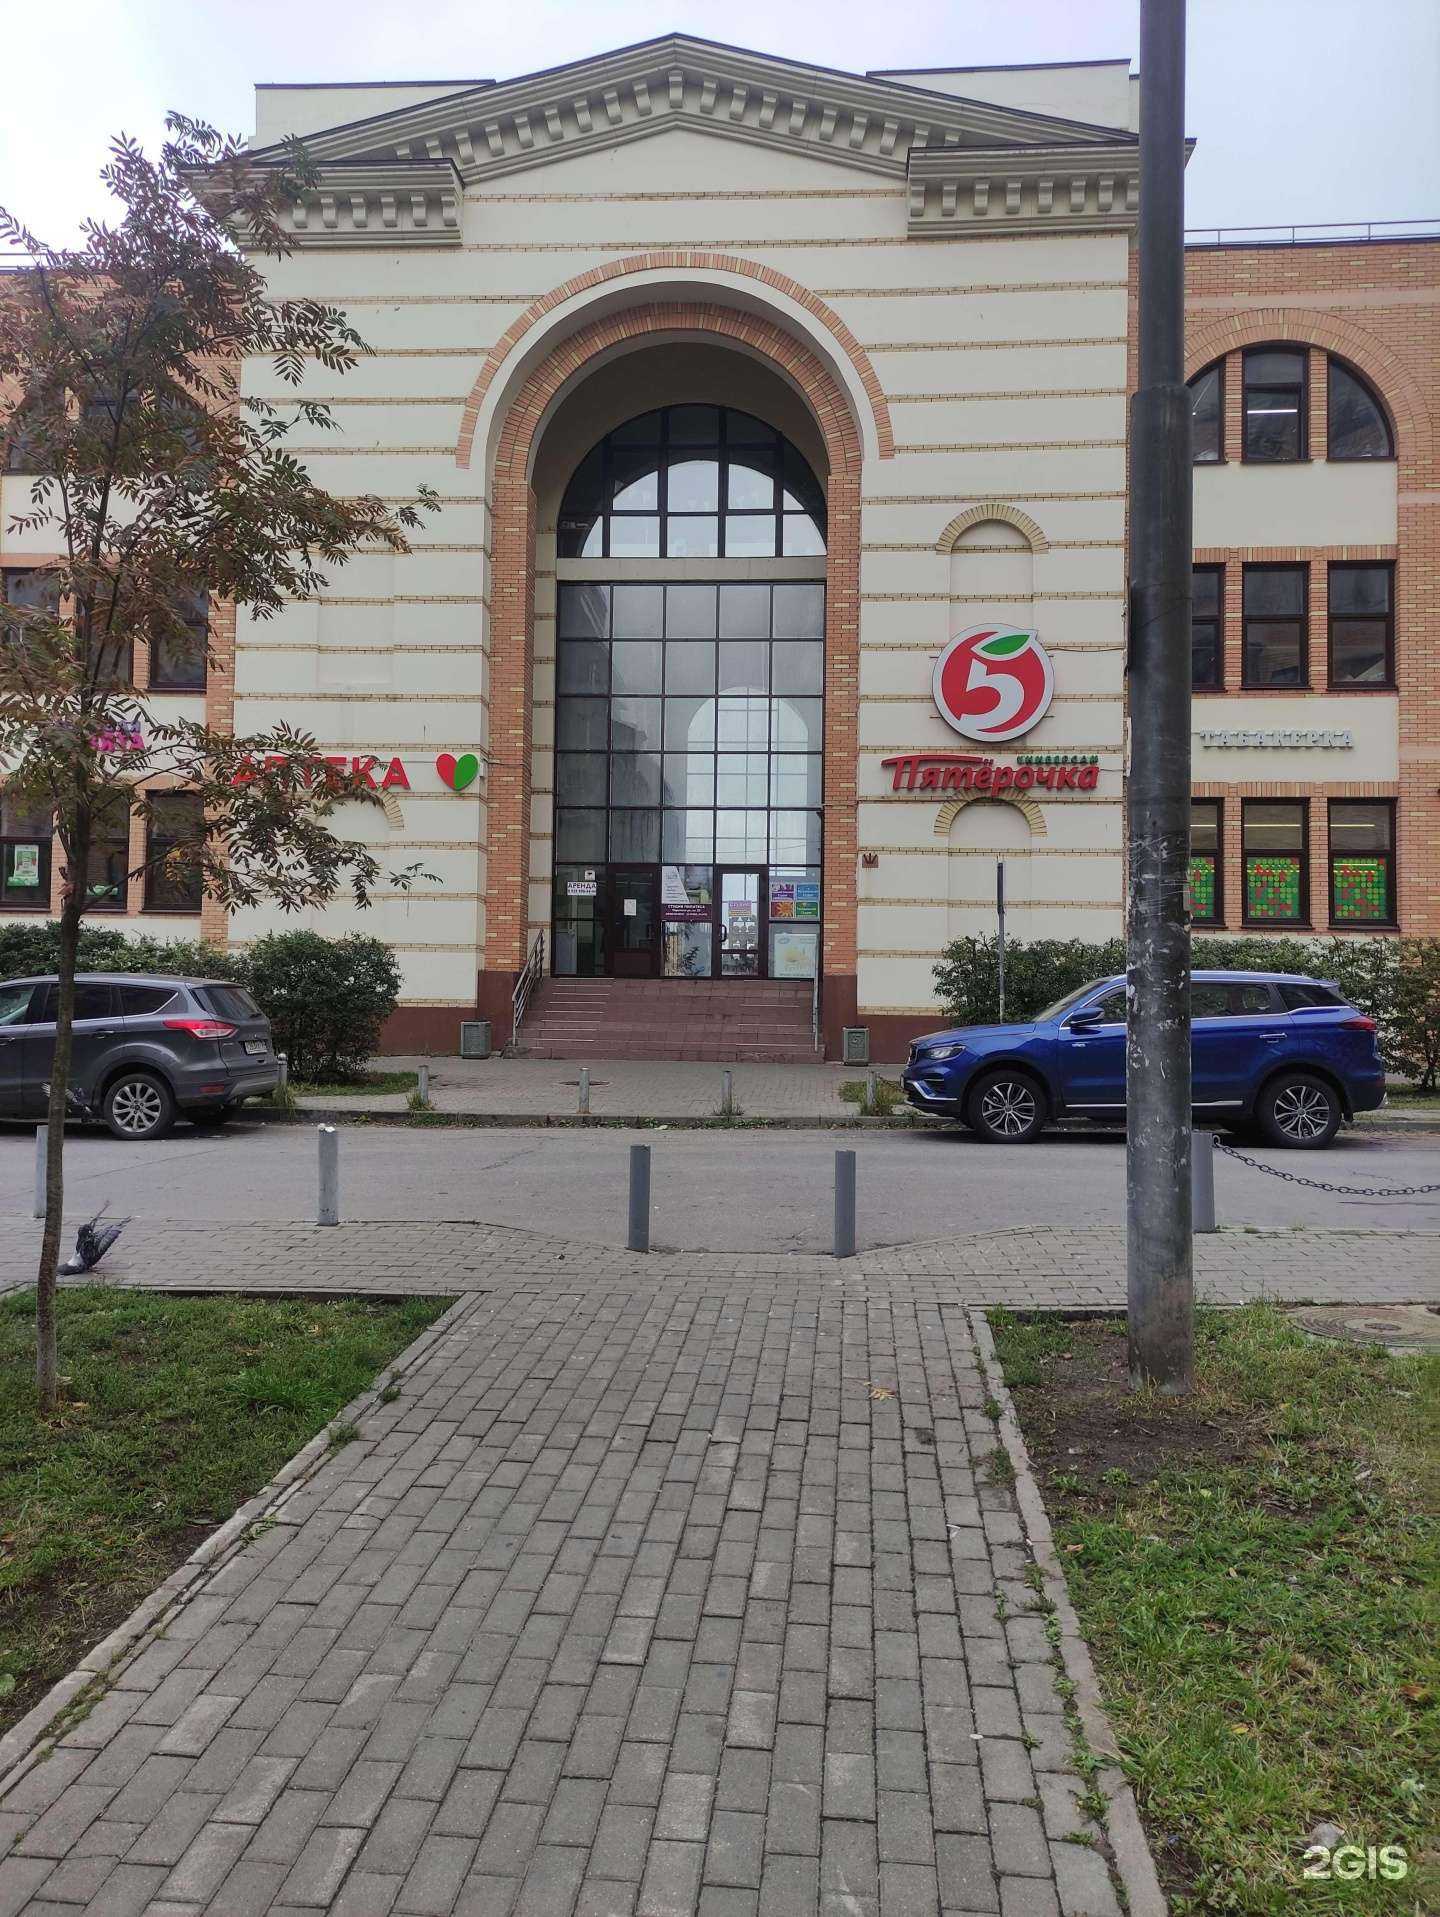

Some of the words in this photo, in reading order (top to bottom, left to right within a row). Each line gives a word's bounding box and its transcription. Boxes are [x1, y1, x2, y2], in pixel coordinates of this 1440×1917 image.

[1200, 730, 1353, 747] ТАБАКЕРКА
[881, 755, 1099, 797] Пятёрочка
[567, 882, 597, 890] АРЕНДА
